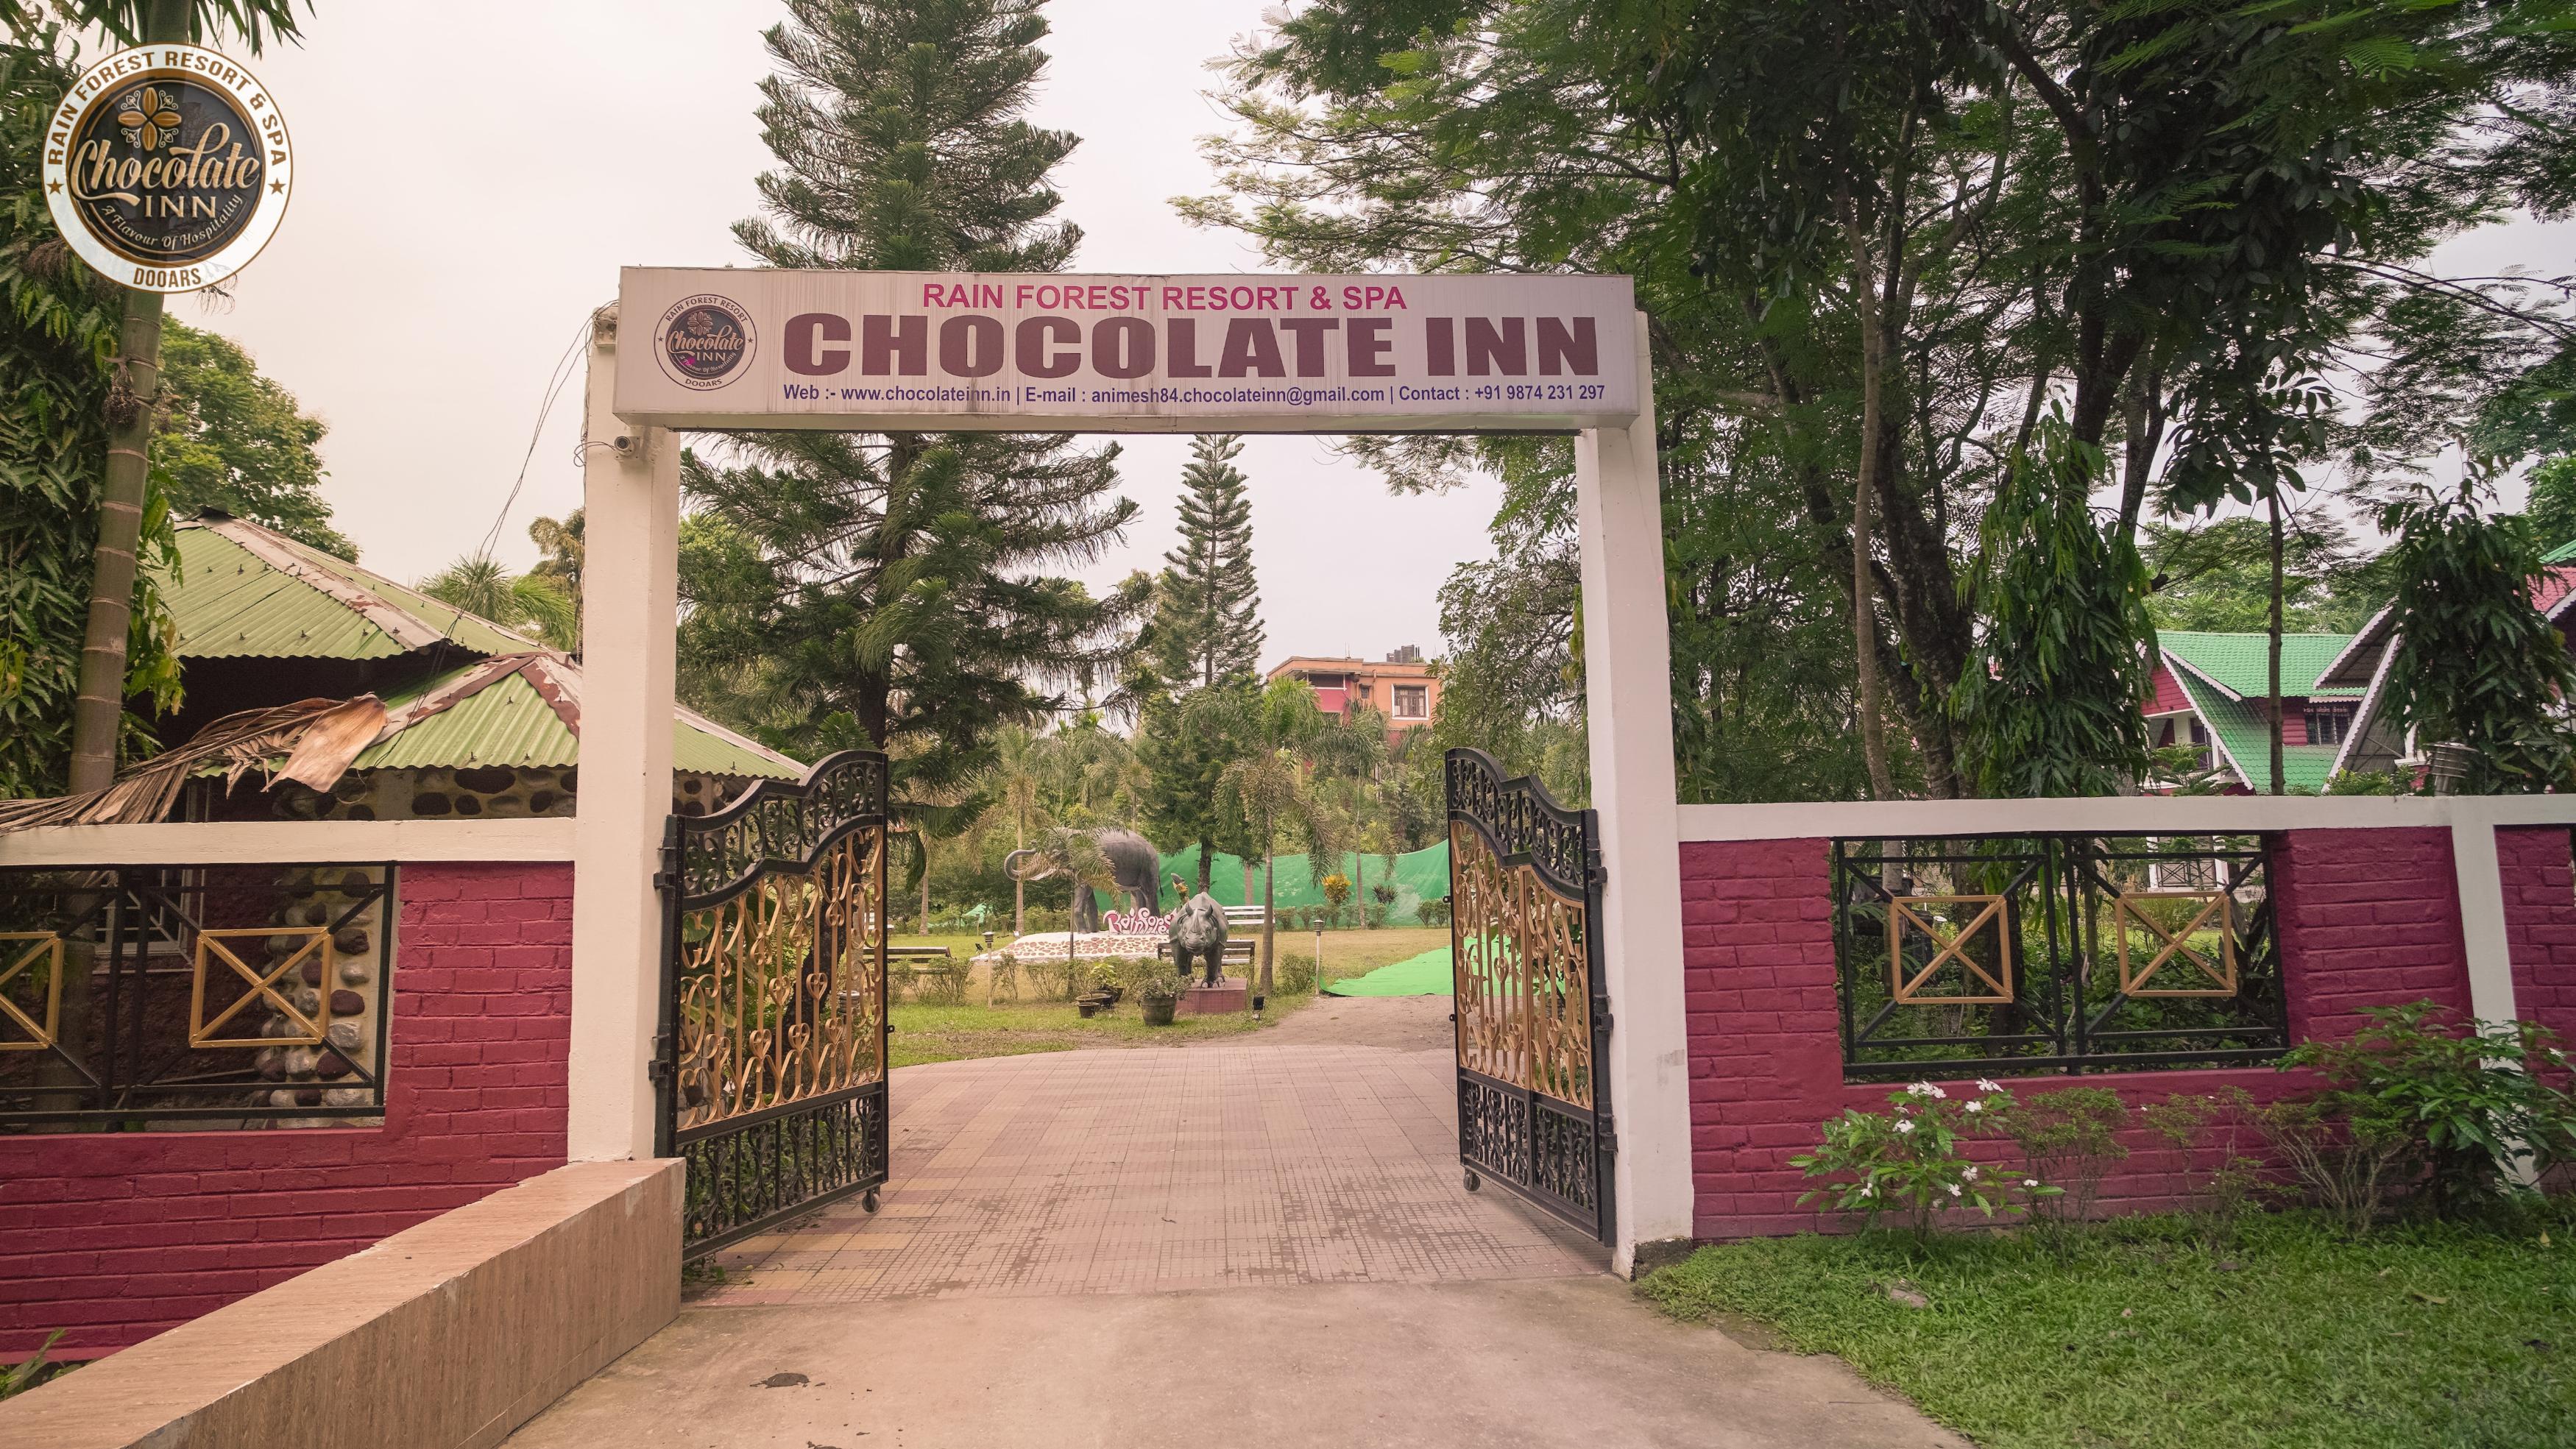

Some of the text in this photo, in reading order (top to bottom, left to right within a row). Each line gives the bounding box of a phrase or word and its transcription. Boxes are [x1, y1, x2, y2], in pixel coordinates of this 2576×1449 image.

[665, 297, 748, 322] RAIN FOREST RESORT
[923, 283, 1407, 311] RAIN FOREST RESORT & SPA
[667, 325, 743, 357] Chocolate
[784, 313, 1599, 378] CHOCOLATE INN
[696, 352, 726, 361] INN
[684, 378, 722, 387] DOOARS
[784, 384, 819, 400] Web
[841, 386, 1011, 401] www.chocolateinn.in
[1026, 387, 1076, 402] E-mail
[1091, 386, 1384, 405] animesh84.chocolateinn@gmail.com
[1399, 386, 1460, 400] Contact
[1475, 385, 1501, 400] +91
[1507, 385, 1543, 400] 9874
[1548, 385, 1574, 400] 231
[1579, 385, 1605, 400] 297
[1103, 907, 1178, 935] Rainfores
